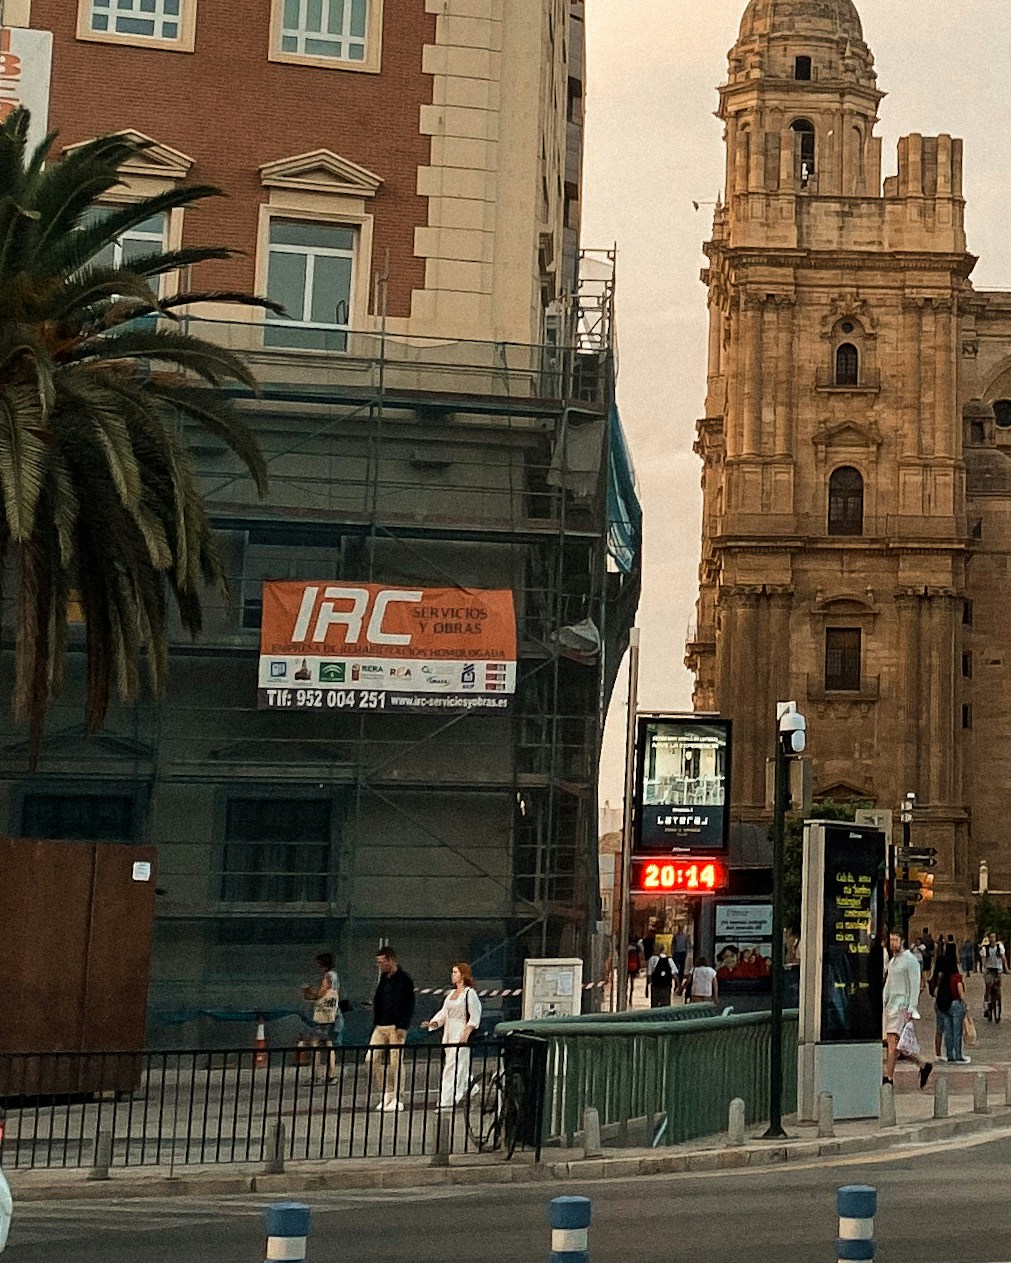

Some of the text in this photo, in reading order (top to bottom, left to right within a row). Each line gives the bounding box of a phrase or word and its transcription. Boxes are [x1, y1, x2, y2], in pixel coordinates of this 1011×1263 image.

[291, 586, 423, 645] IRC
[412, 606, 488, 620] SERVICIOS
[418, 622, 482, 635] Y OBRAS
[297, 690, 323, 707] 952
[327, 691, 355, 708] 004
[359, 691, 386, 709] 251
[391, 695, 508, 710] www.irc-serviciosyobras.es
[644, 864, 716, 888] 20:14
